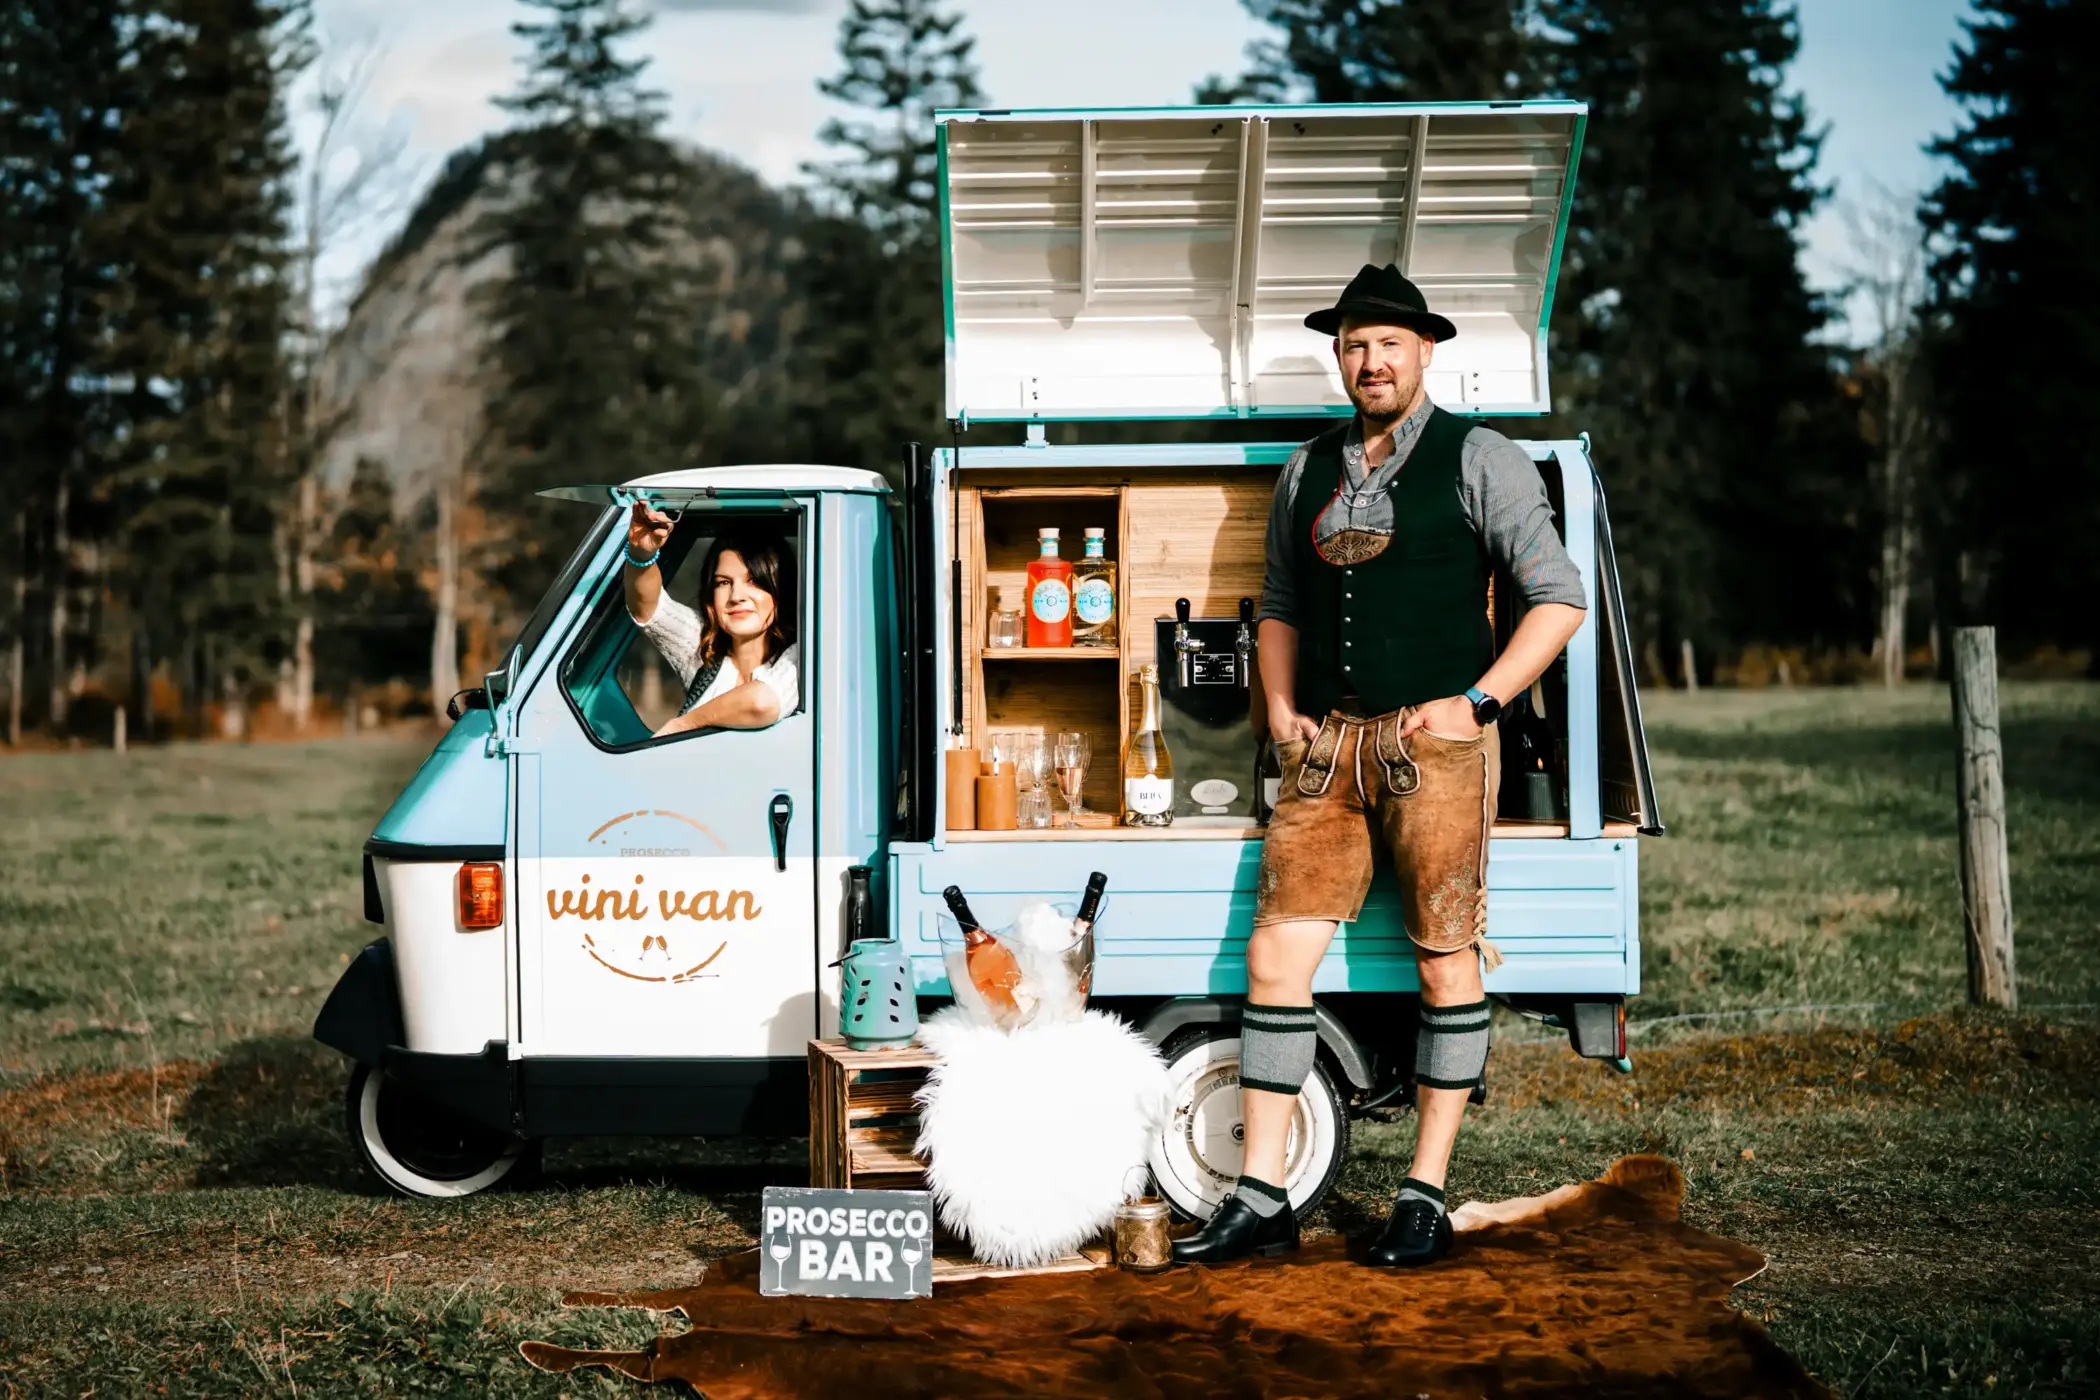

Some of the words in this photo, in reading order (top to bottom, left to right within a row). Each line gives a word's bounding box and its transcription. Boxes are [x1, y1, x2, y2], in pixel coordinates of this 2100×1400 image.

[620, 848, 691, 858] PROSECCO
[546, 873, 649, 921] vini
[658, 889, 762, 922] van
[766, 1206, 929, 1238] PROSECCO
[798, 1239, 894, 1283] BAR
